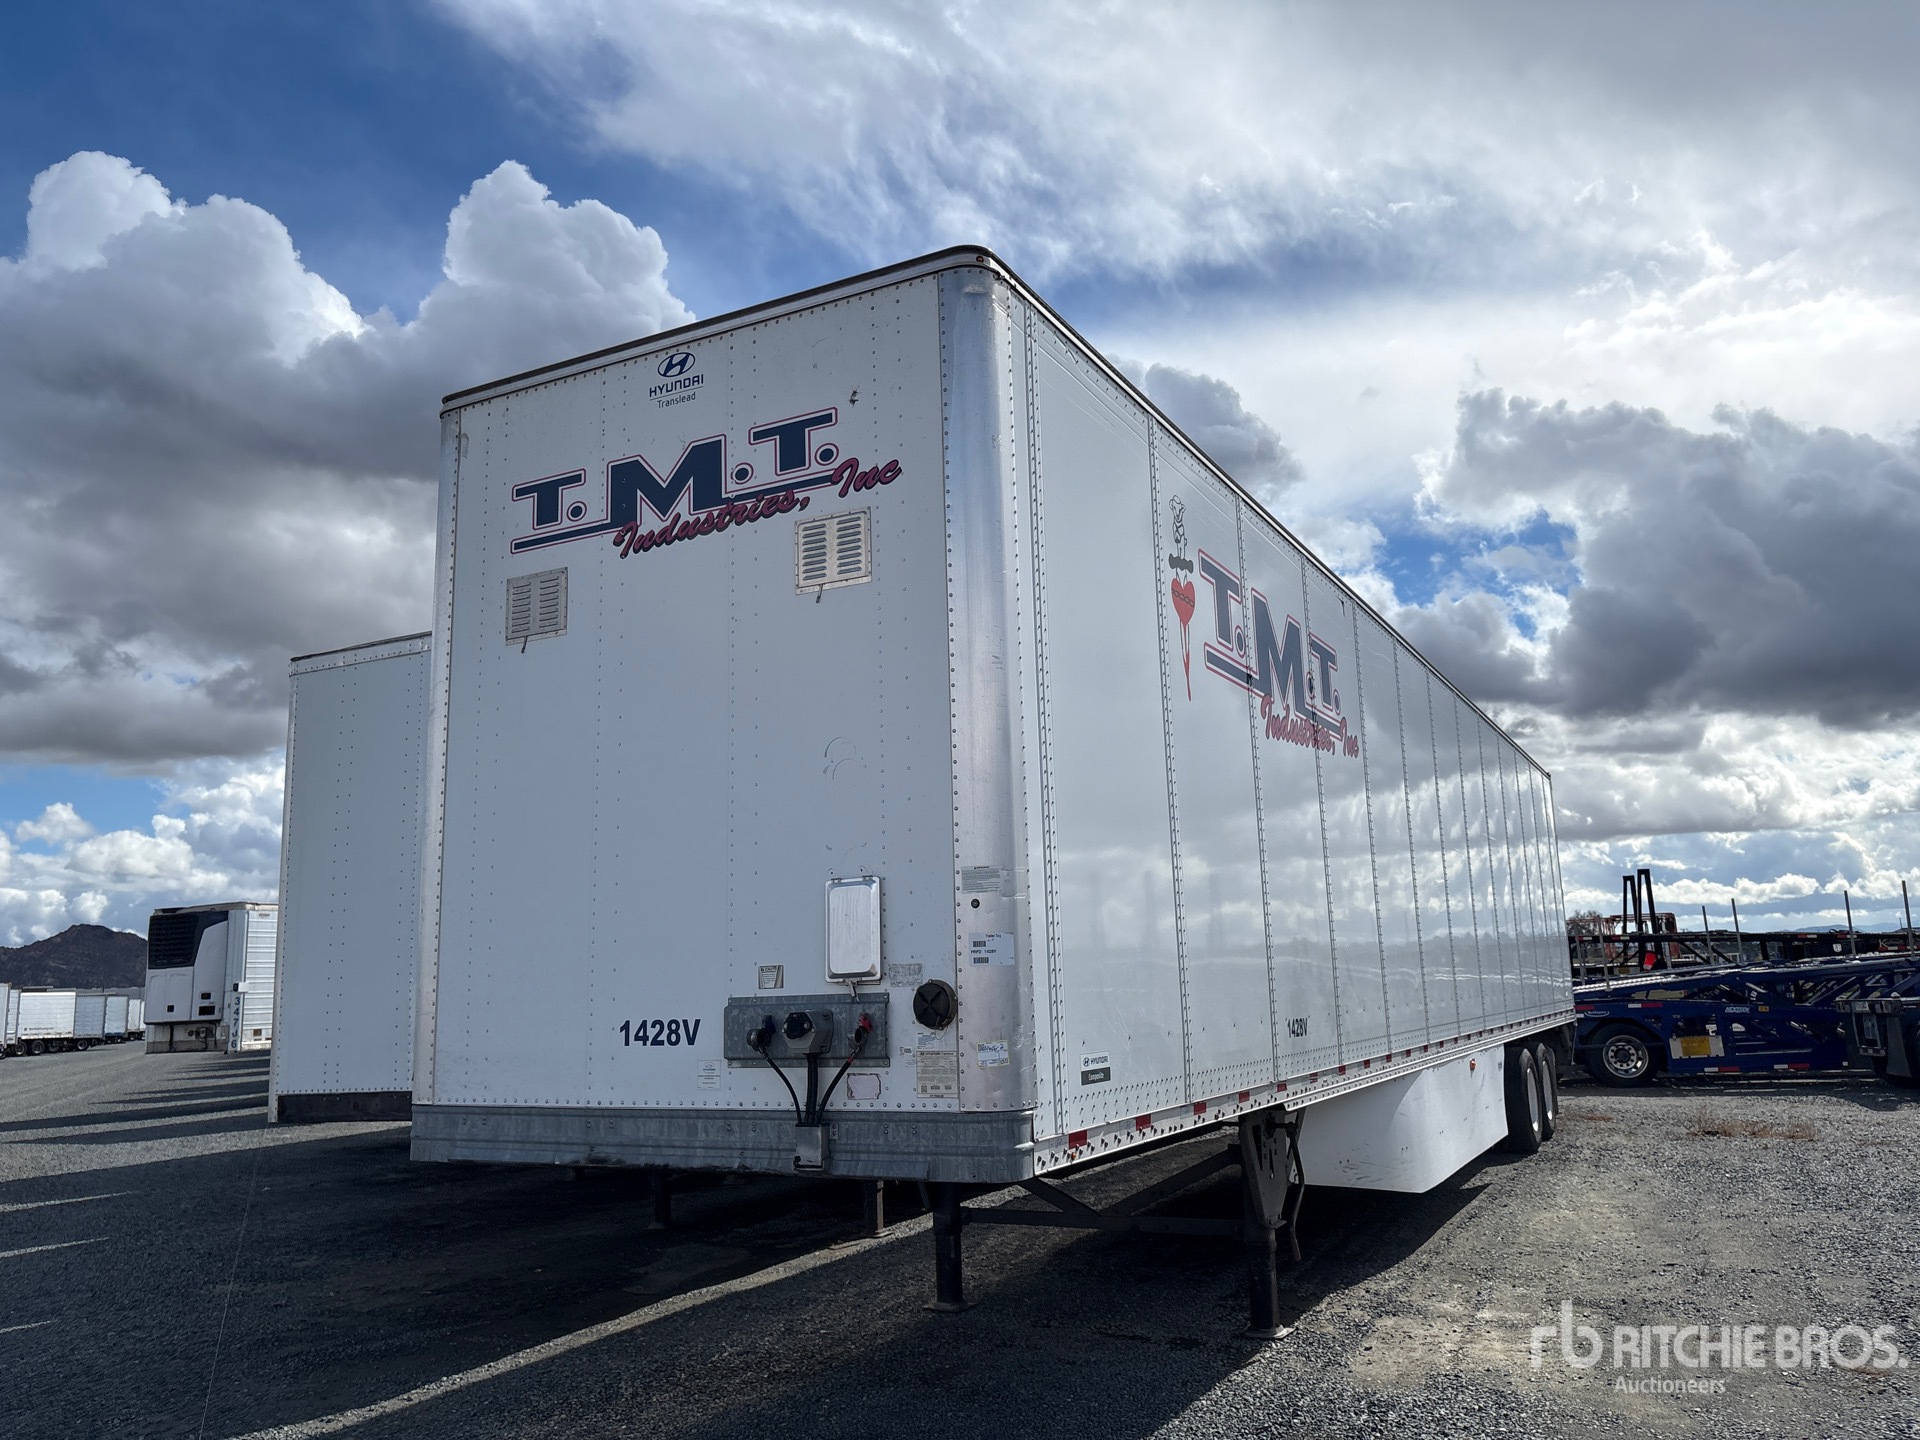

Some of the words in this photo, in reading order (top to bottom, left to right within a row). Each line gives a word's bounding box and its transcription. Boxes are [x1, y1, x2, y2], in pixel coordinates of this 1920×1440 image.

[649, 373, 704, 398] HYUNDAI
[657, 391, 696, 409] Translead
[511, 407, 839, 534] T.M.T.
[613, 488, 811, 559] Industries,
[831, 457, 902, 498] Inc
[619, 1018, 701, 1047] 1428V
[1287, 1017, 1308, 1039] 1428V
[1090, 1055, 1109, 1065] HYUNDAI
